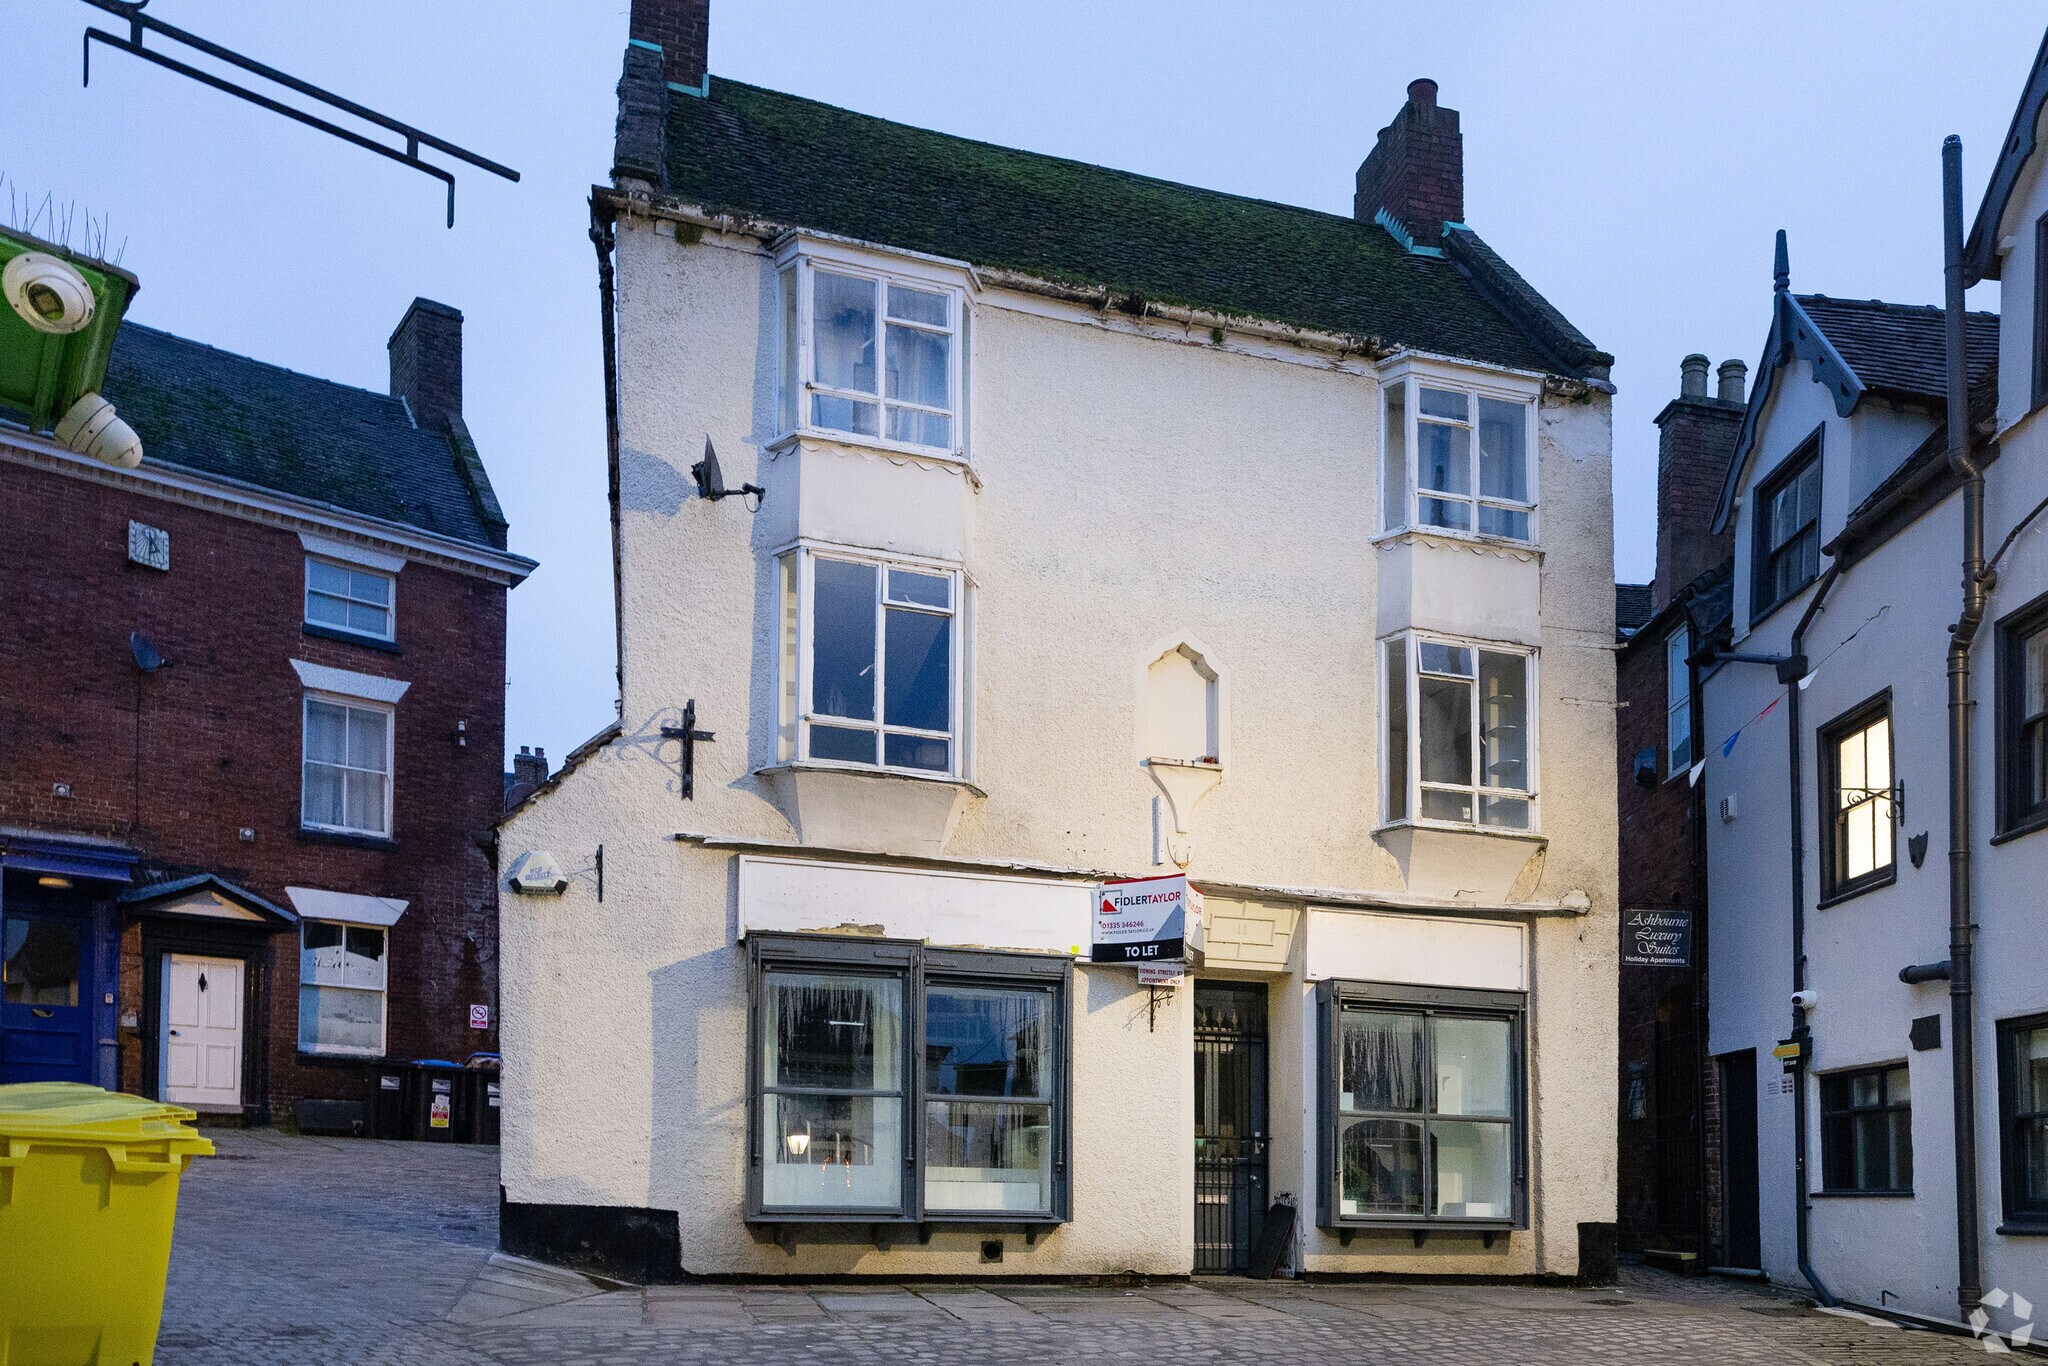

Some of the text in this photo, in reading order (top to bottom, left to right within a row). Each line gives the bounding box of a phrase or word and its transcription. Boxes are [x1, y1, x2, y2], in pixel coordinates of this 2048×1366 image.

[1122, 920, 1145, 928] 346246
[1627, 912, 1689, 927] Ashbourne
[1635, 926, 1682, 945] Luxury
[1125, 945, 1159, 957] TO LET
[1637, 941, 1680, 955] Suites
[1625, 955, 1686, 964] Holiday Apartments
